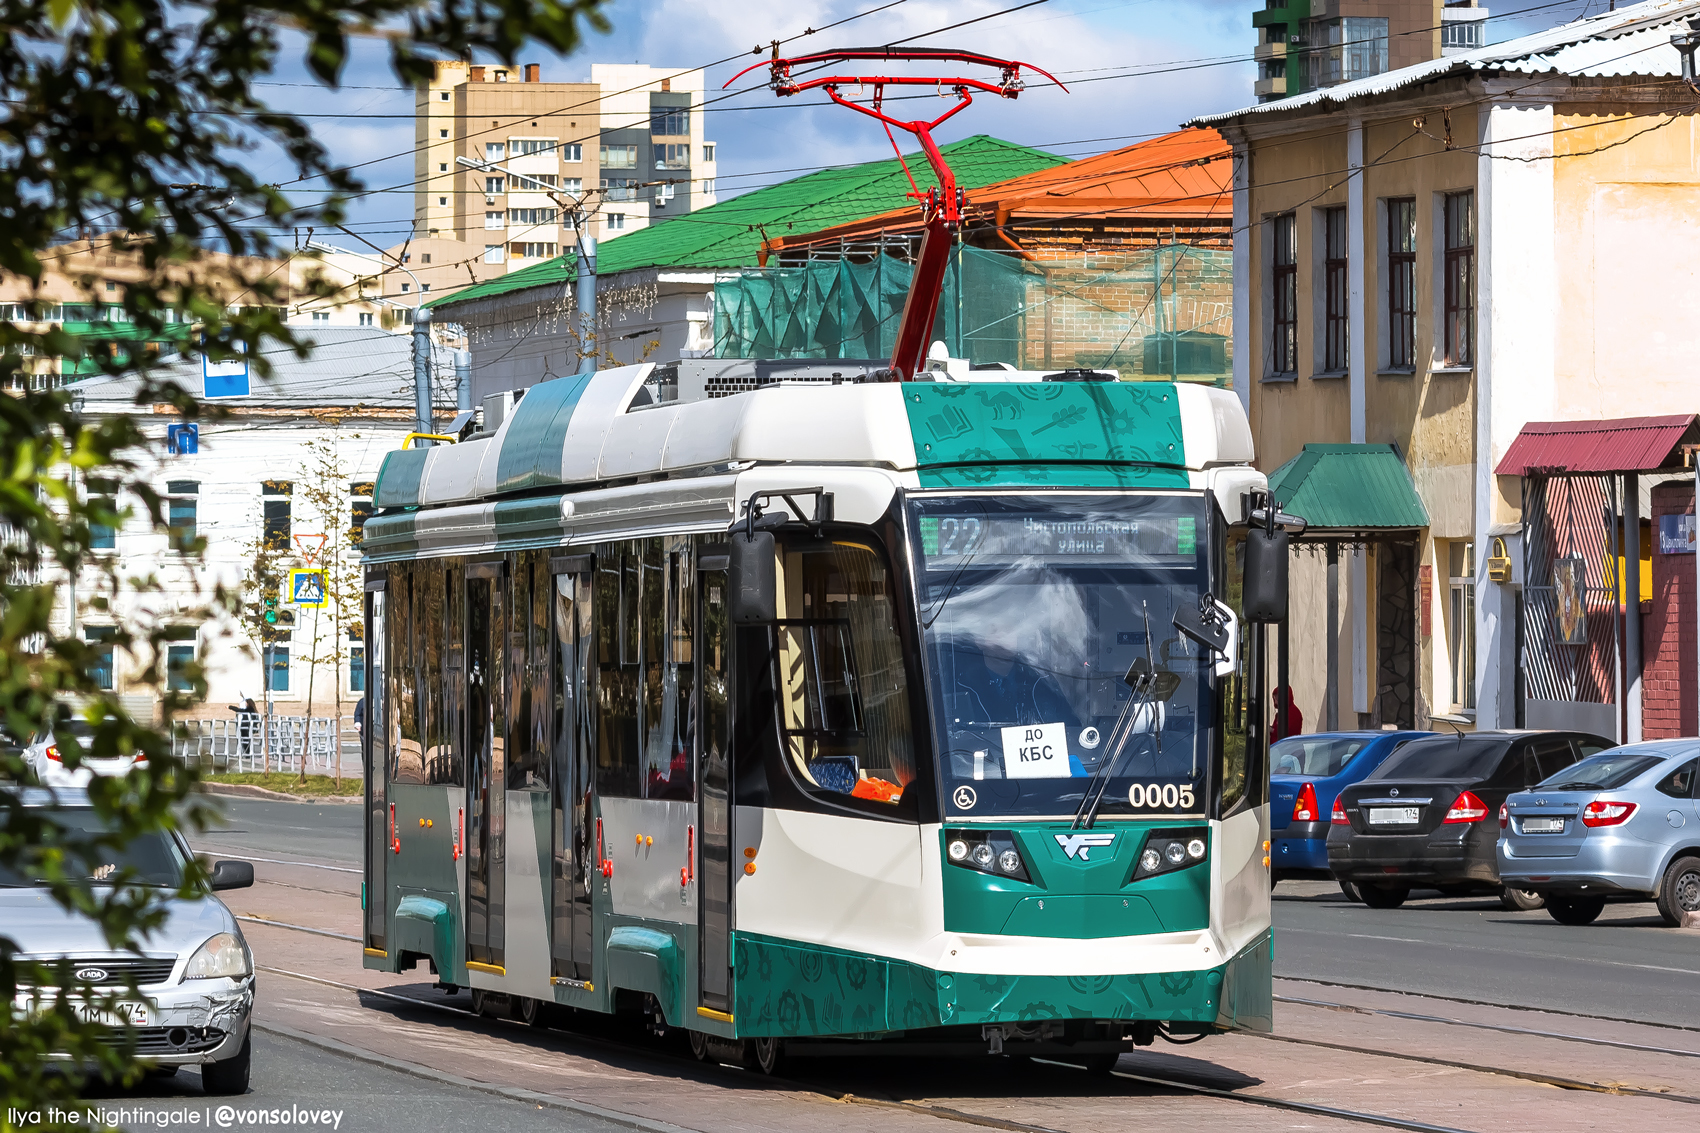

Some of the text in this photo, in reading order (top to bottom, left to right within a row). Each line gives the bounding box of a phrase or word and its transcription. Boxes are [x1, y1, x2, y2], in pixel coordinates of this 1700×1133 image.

[1023, 516, 1139, 536] Чистопольская
[941, 517, 981, 556] 22
[1058, 539, 1105, 554] улица
[1025, 728, 1043, 743] ДО
[1019, 744, 1054, 763] КБС
[1128, 783, 1195, 808] 0005
[1405, 808, 1418, 817] 174
[117, 1003, 143, 1018] 174
